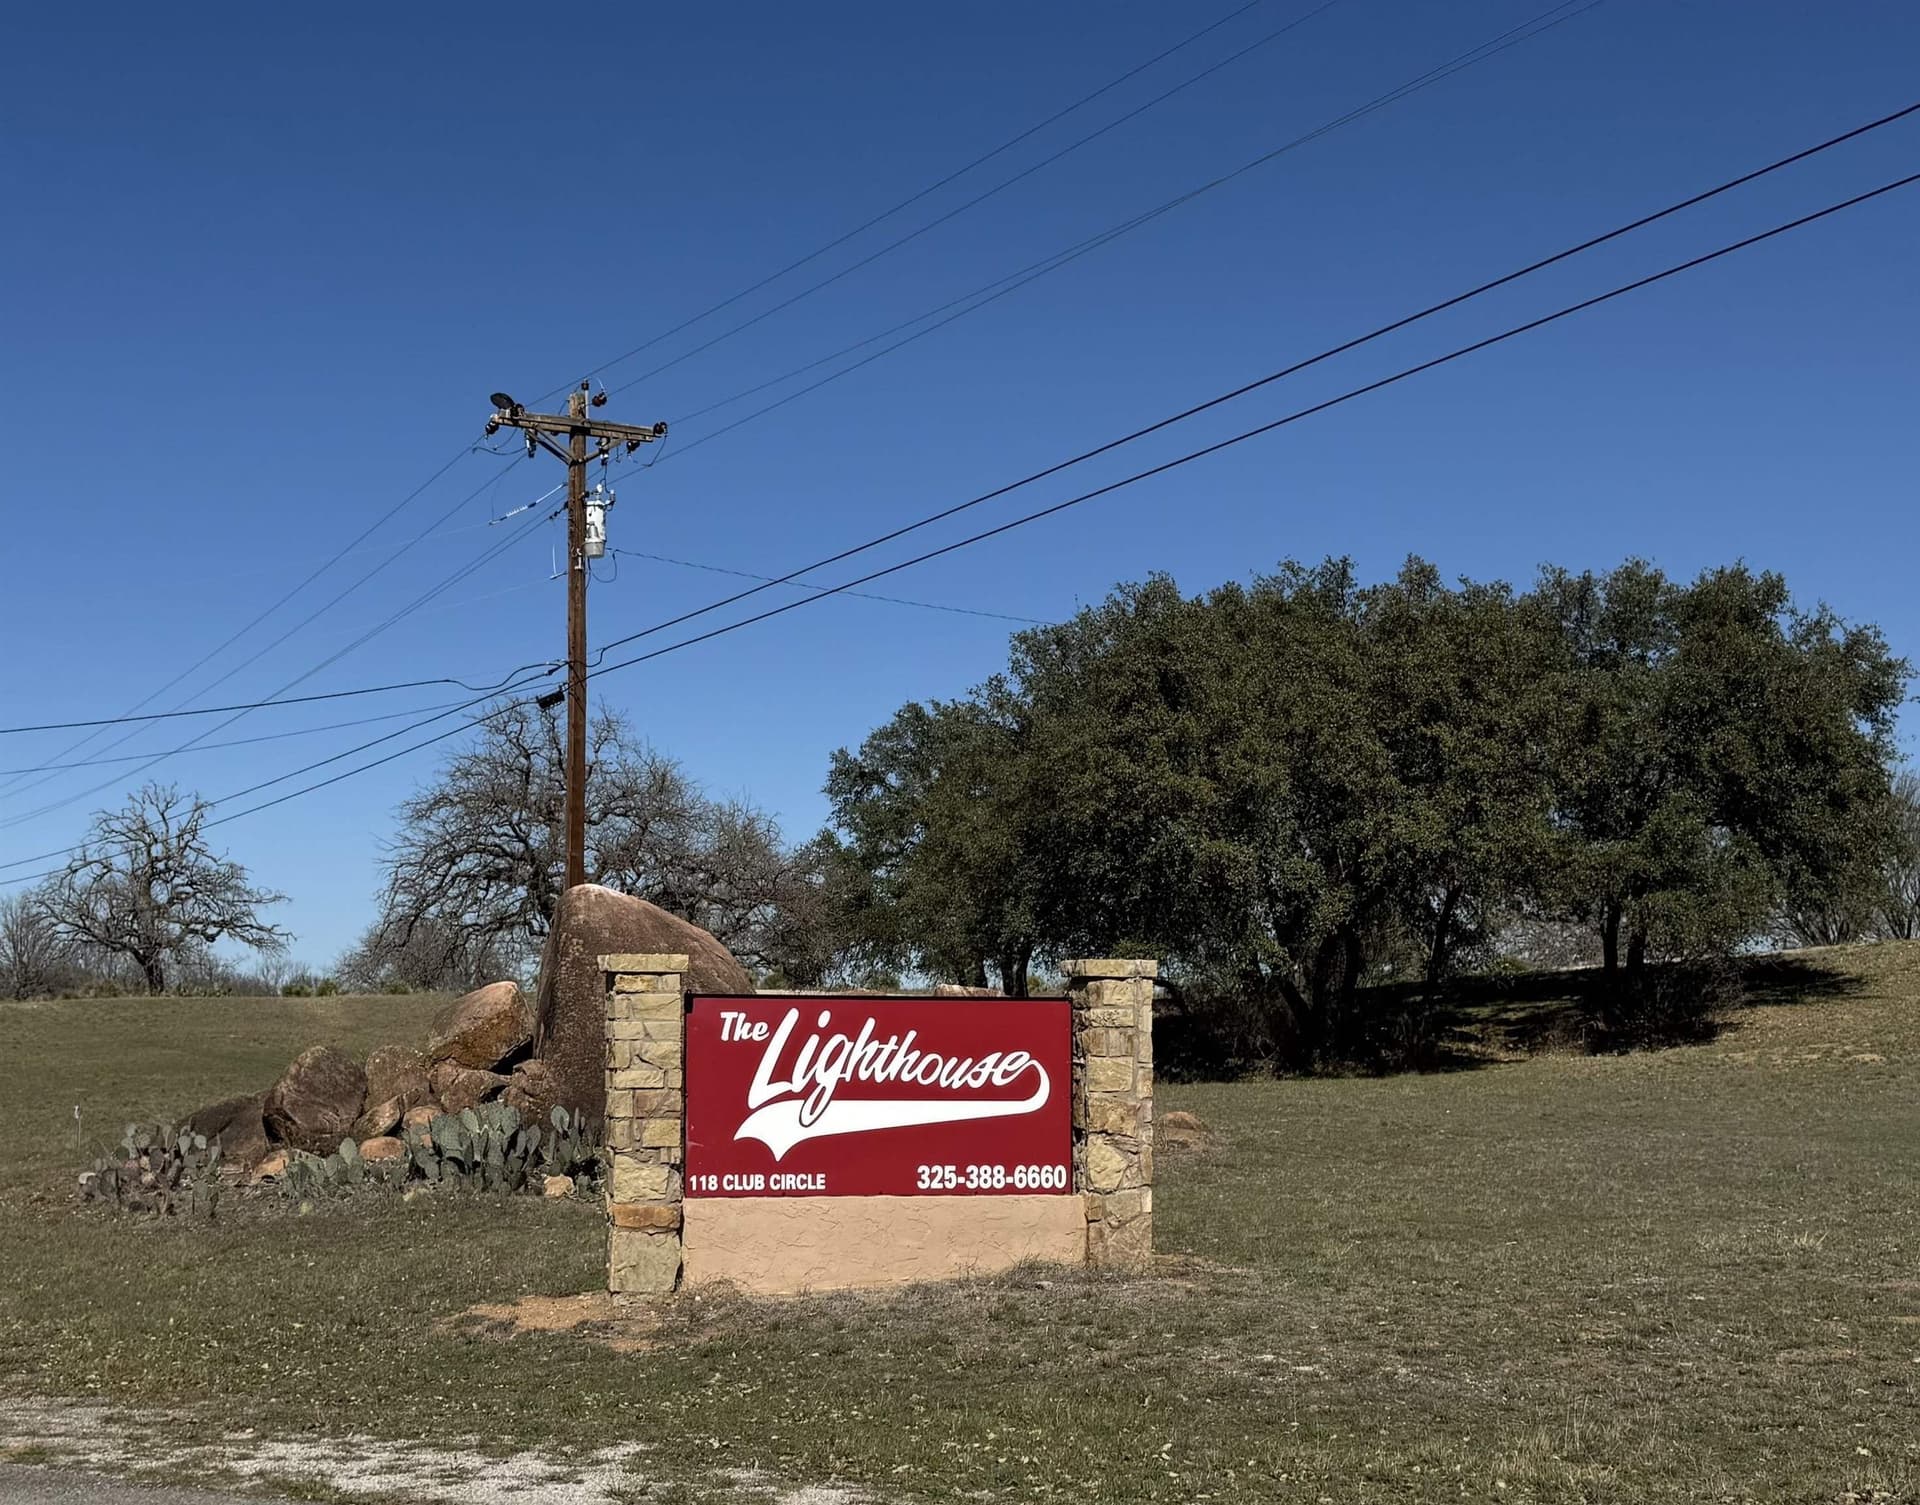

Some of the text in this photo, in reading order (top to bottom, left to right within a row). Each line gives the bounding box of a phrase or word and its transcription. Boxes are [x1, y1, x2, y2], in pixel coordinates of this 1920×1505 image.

[720, 1007, 1034, 1127] The Lighthouse
[689, 1173, 826, 1191] 118 CLUB CIRCLE
[916, 1164, 1067, 1190] 325-388-6660
